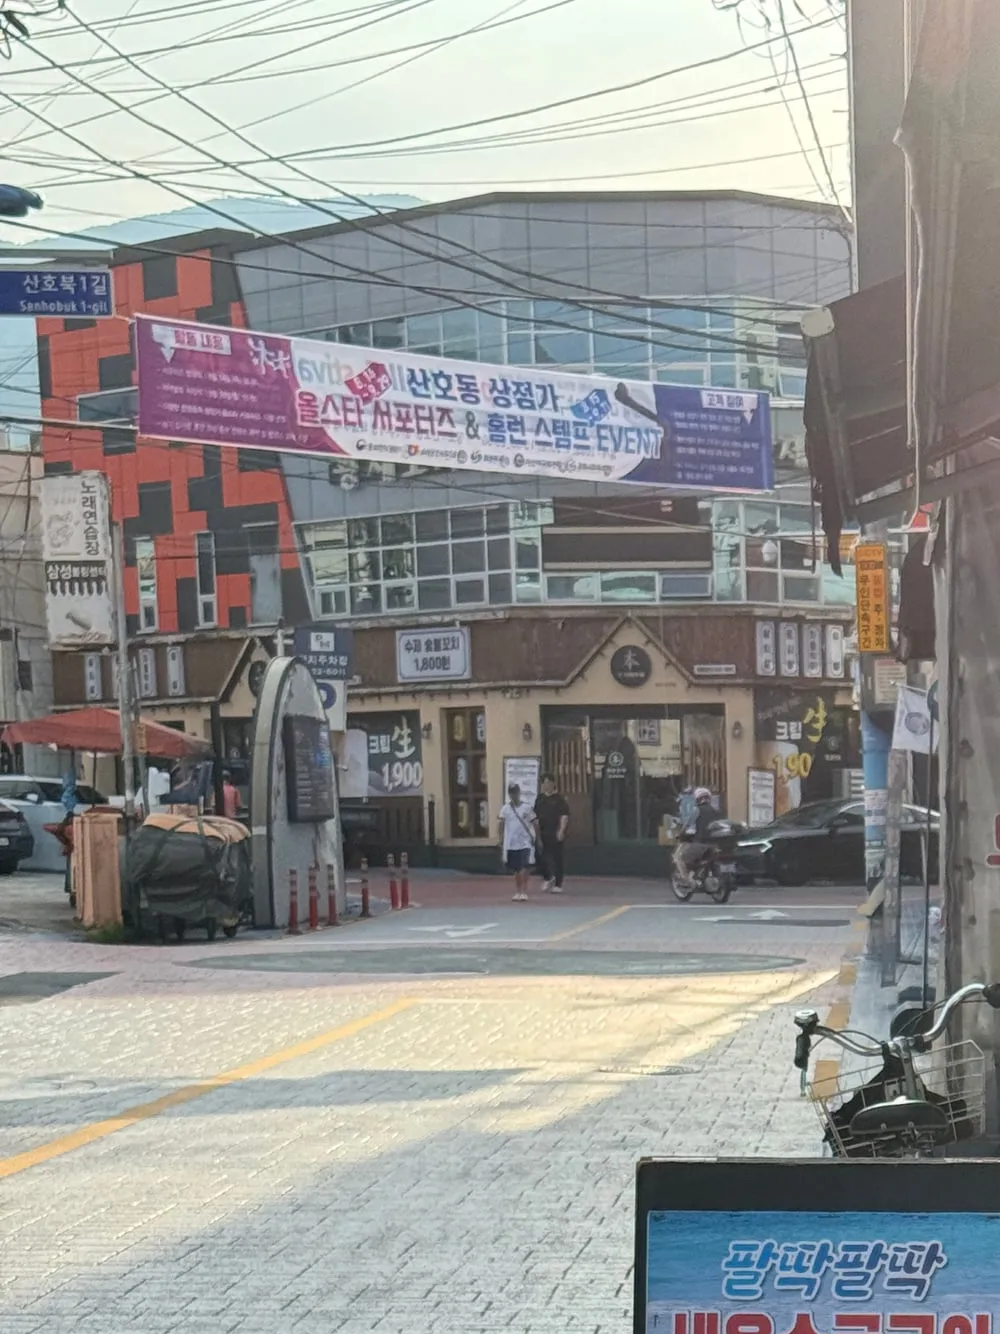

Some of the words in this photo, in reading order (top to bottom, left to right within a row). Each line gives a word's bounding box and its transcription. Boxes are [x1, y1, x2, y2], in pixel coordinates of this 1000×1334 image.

[23, 273, 107, 296] 산호북1길
[19, 299, 78, 313] Sanhobuk
[81, 300, 108, 315] 1-gil
[407, 367, 481, 405] 산호동
[489, 377, 561, 413] 상점가
[297, 391, 364, 428] 올스타
[371, 399, 457, 438] 서포터즈
[487, 412, 527, 445] 홈런
[595, 423, 663, 459] EVENT
[81, 480, 99, 556] 노래연습장
[369, 734, 391, 754] 크림
[776, 720, 803, 740] 크림
[382, 761, 422, 792] 1,900
[722, 1238, 947, 1302] 팔딱팔딱
